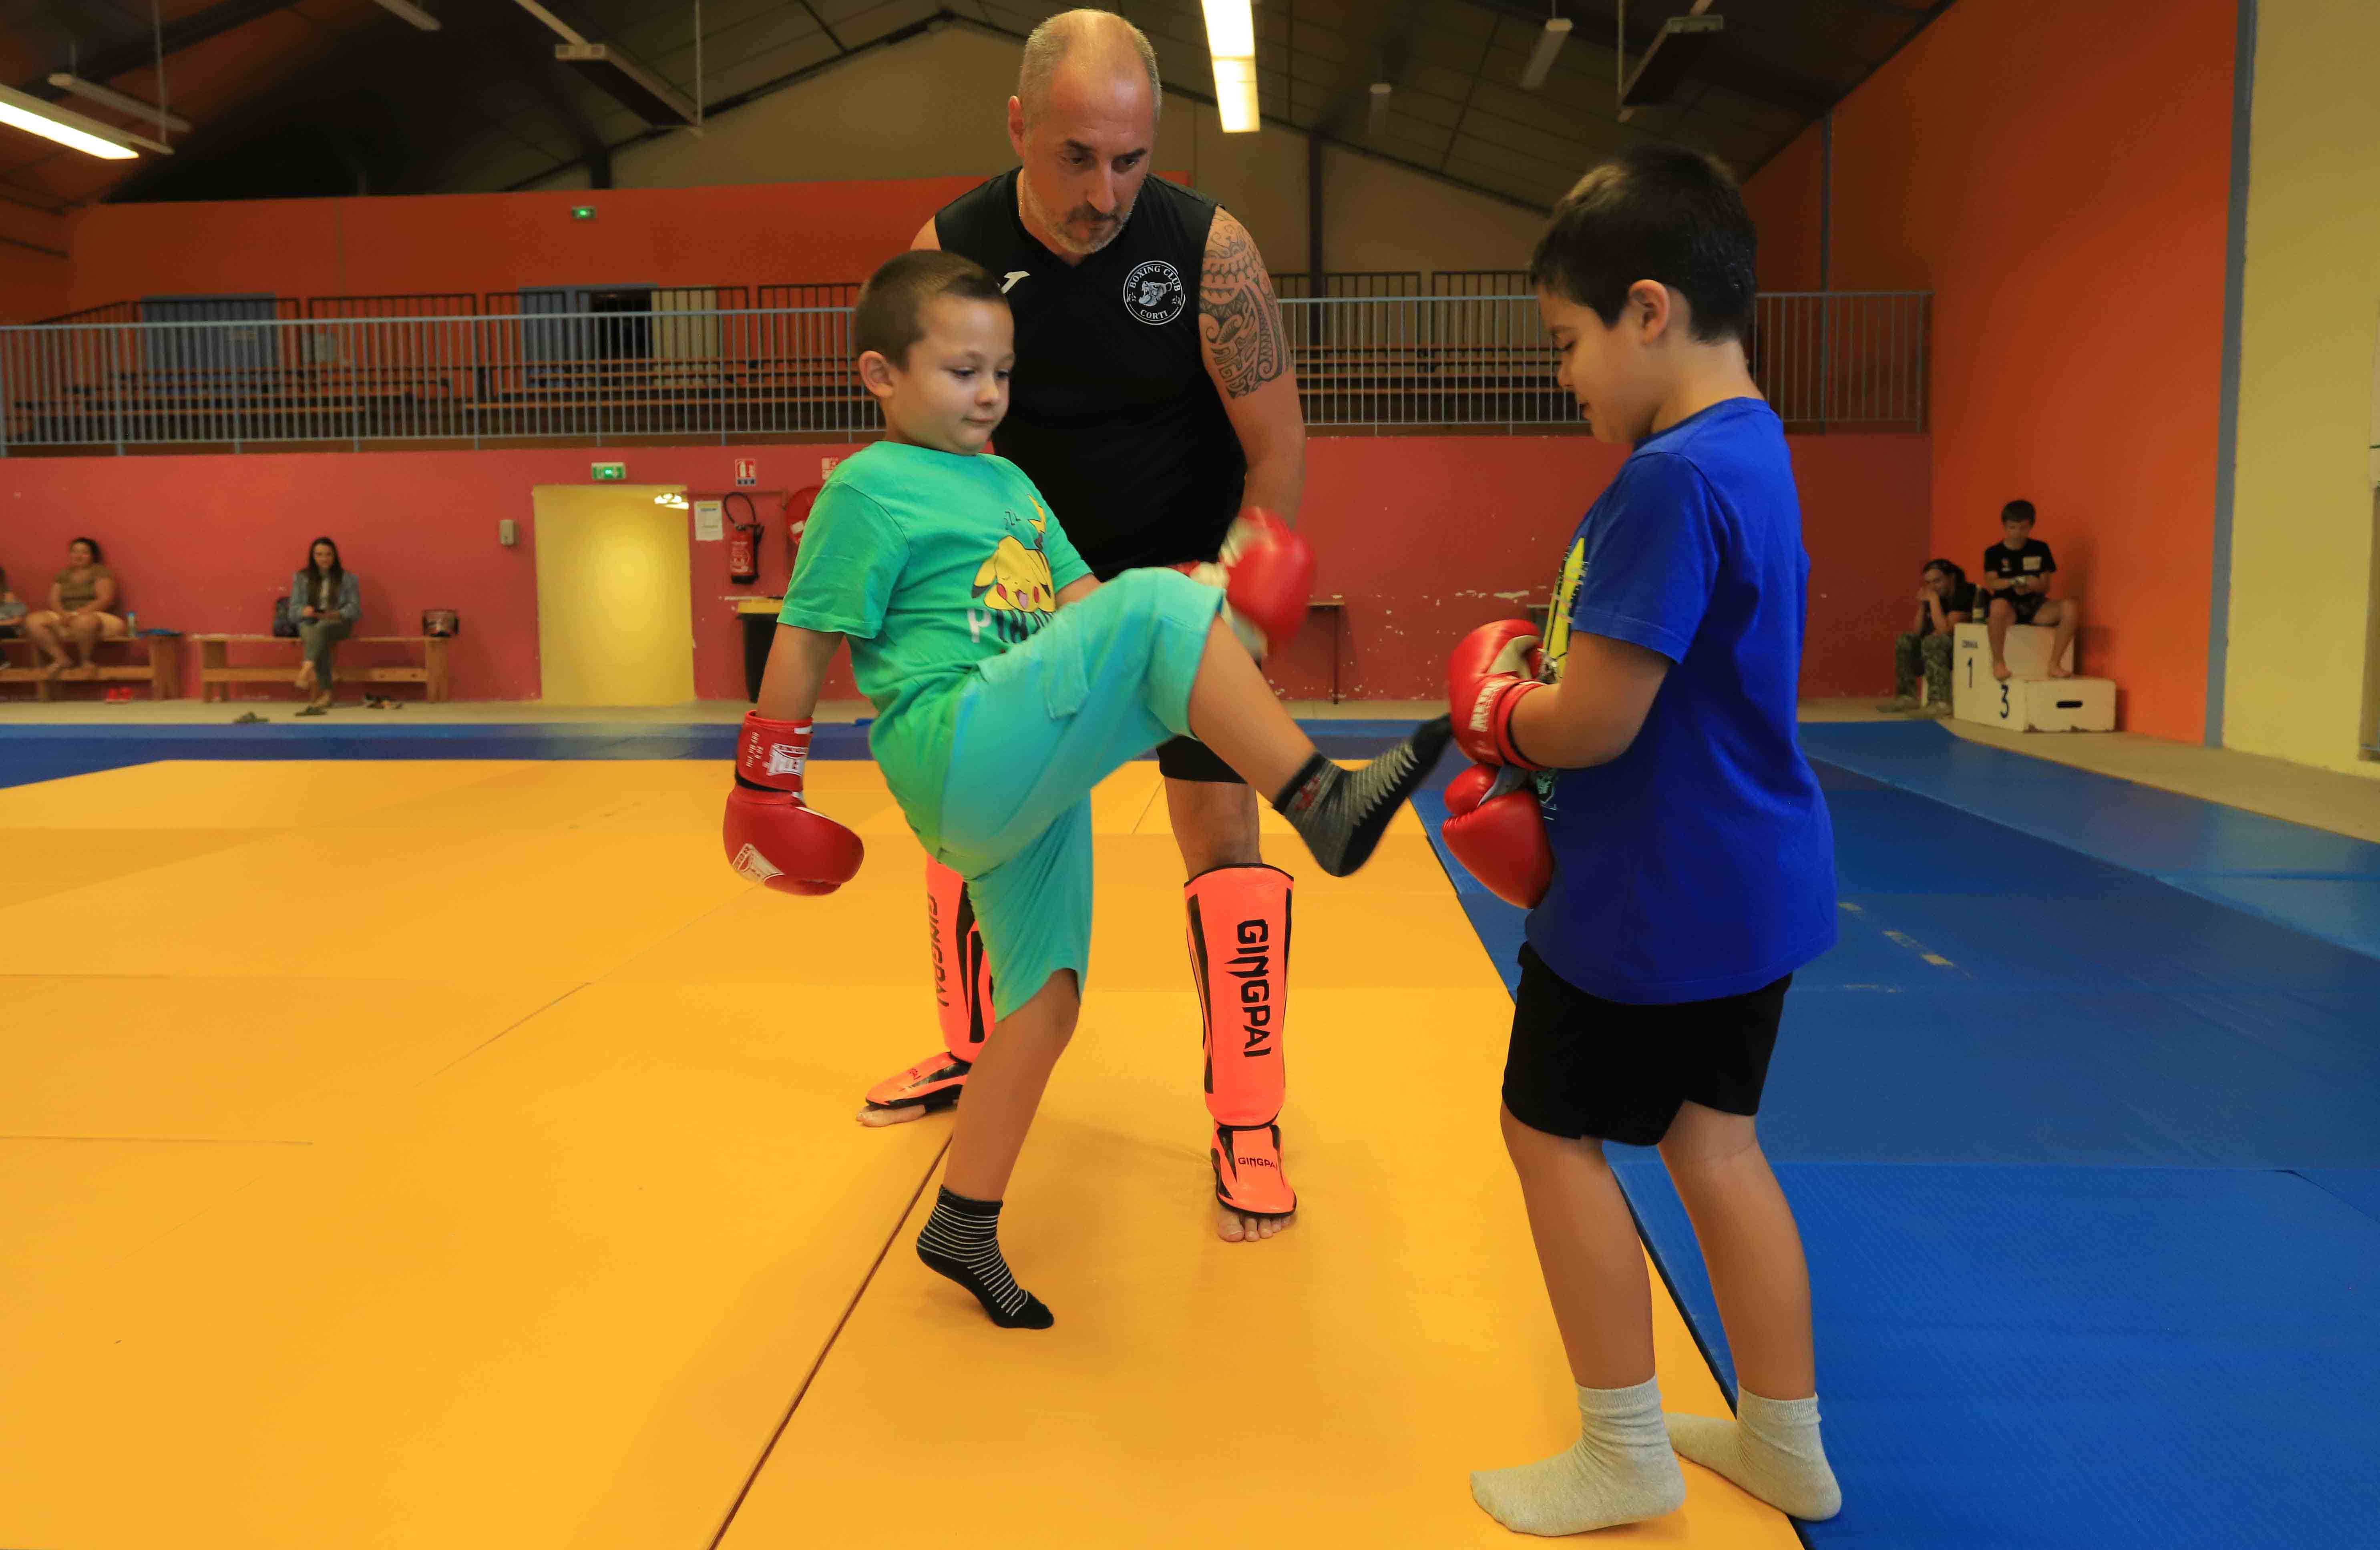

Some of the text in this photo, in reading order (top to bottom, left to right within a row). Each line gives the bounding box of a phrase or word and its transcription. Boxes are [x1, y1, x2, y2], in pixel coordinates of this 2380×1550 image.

[1129, 265, 1181, 291] BOXING CLUB
[1140, 309, 1168, 319] CORTI
[1967, 657, 1973, 688] 1
[2000, 685, 2010, 718] 3
[1224, 919, 1272, 1058] GINGPAI
[1238, 1157, 1278, 1171] GINGPAI
